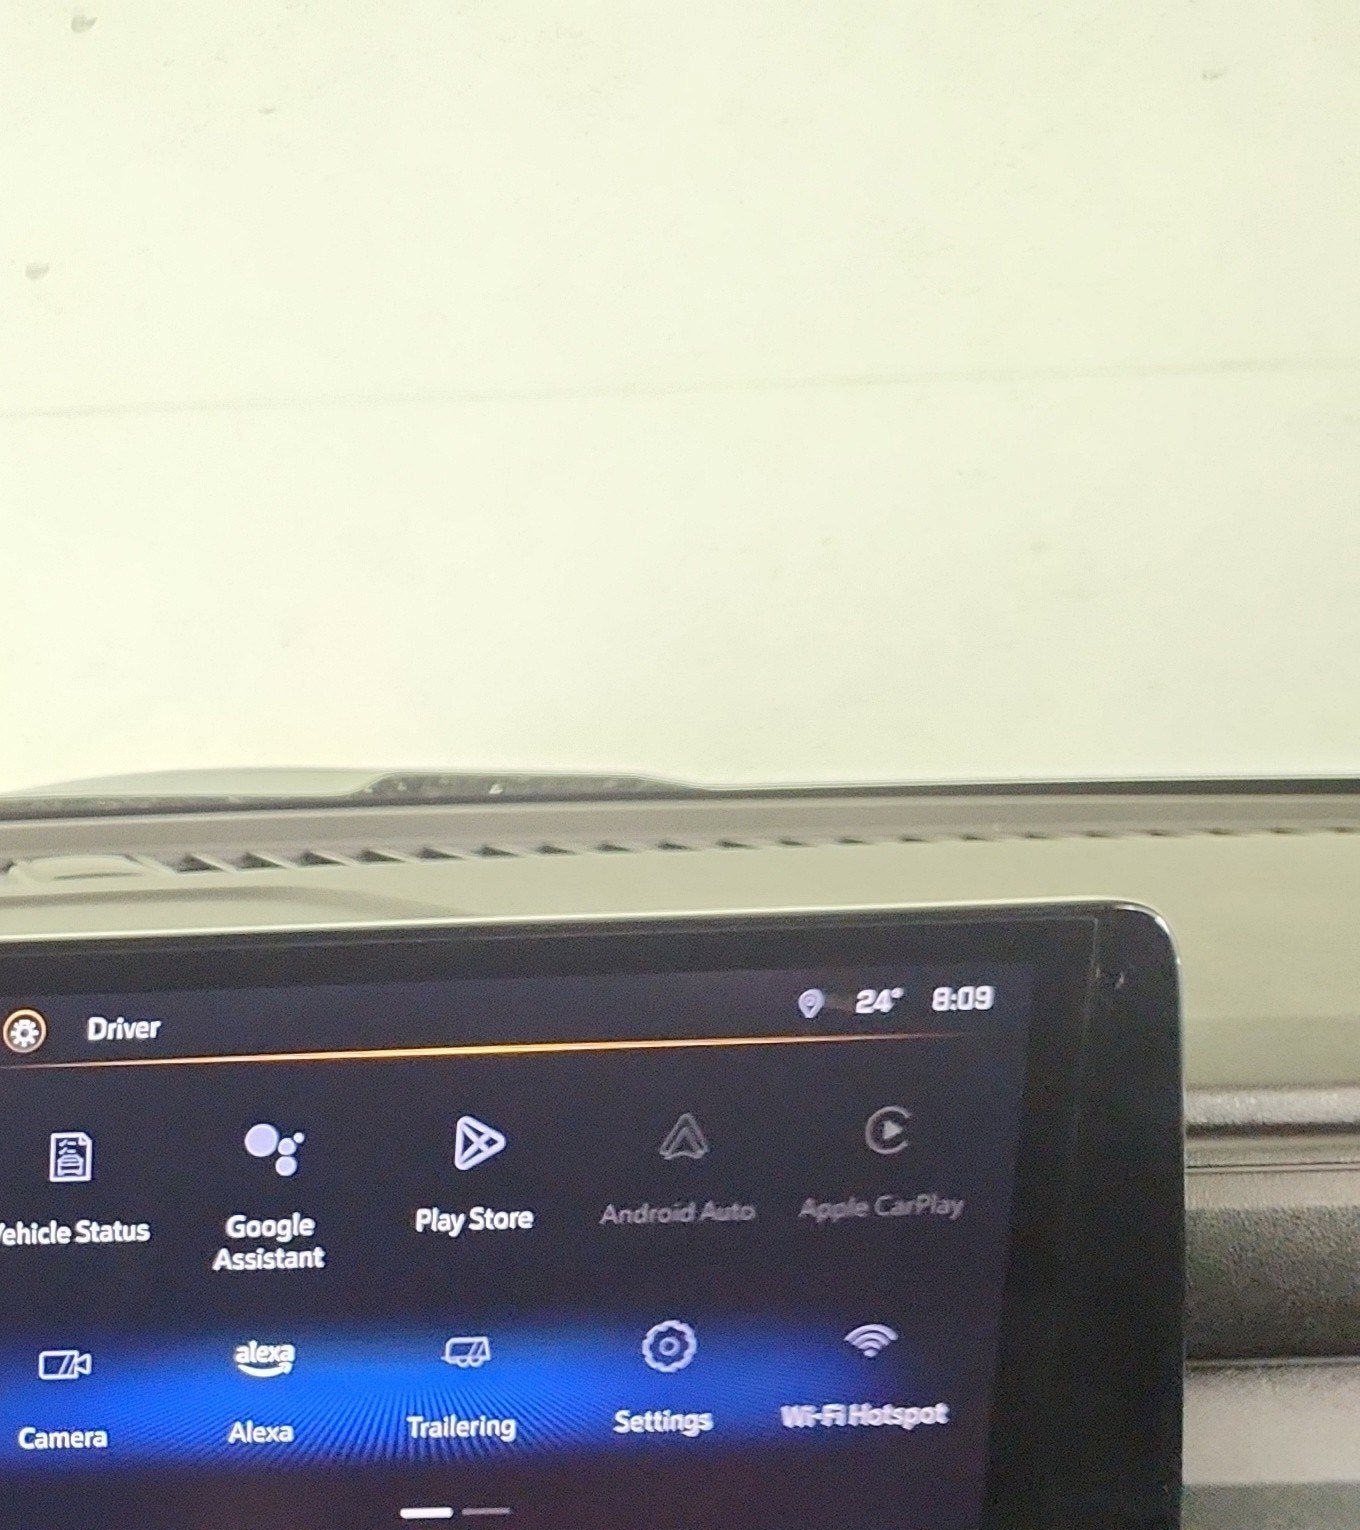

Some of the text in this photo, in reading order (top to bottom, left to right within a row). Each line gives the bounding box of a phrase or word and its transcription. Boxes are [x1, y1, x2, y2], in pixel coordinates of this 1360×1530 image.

[87, 1016, 161, 1042] Driver
[415, 1206, 535, 1238] Play Store
[599, 1200, 757, 1226] Android Auto
[797, 1193, 965, 1225] Apple CarPlay
[75, 1219, 151, 1244] Status
[225, 1211, 316, 1243] Google
[212, 1245, 326, 1272] Assistant
[235, 1340, 296, 1364] alexa
[407, 1413, 517, 1443] Trailering
[613, 1408, 714, 1438] Settings
[781, 1402, 950, 1431] Wi-Fi Hotspot
[17, 1425, 109, 1451] Camera
[227, 1420, 295, 1445] Alexa
